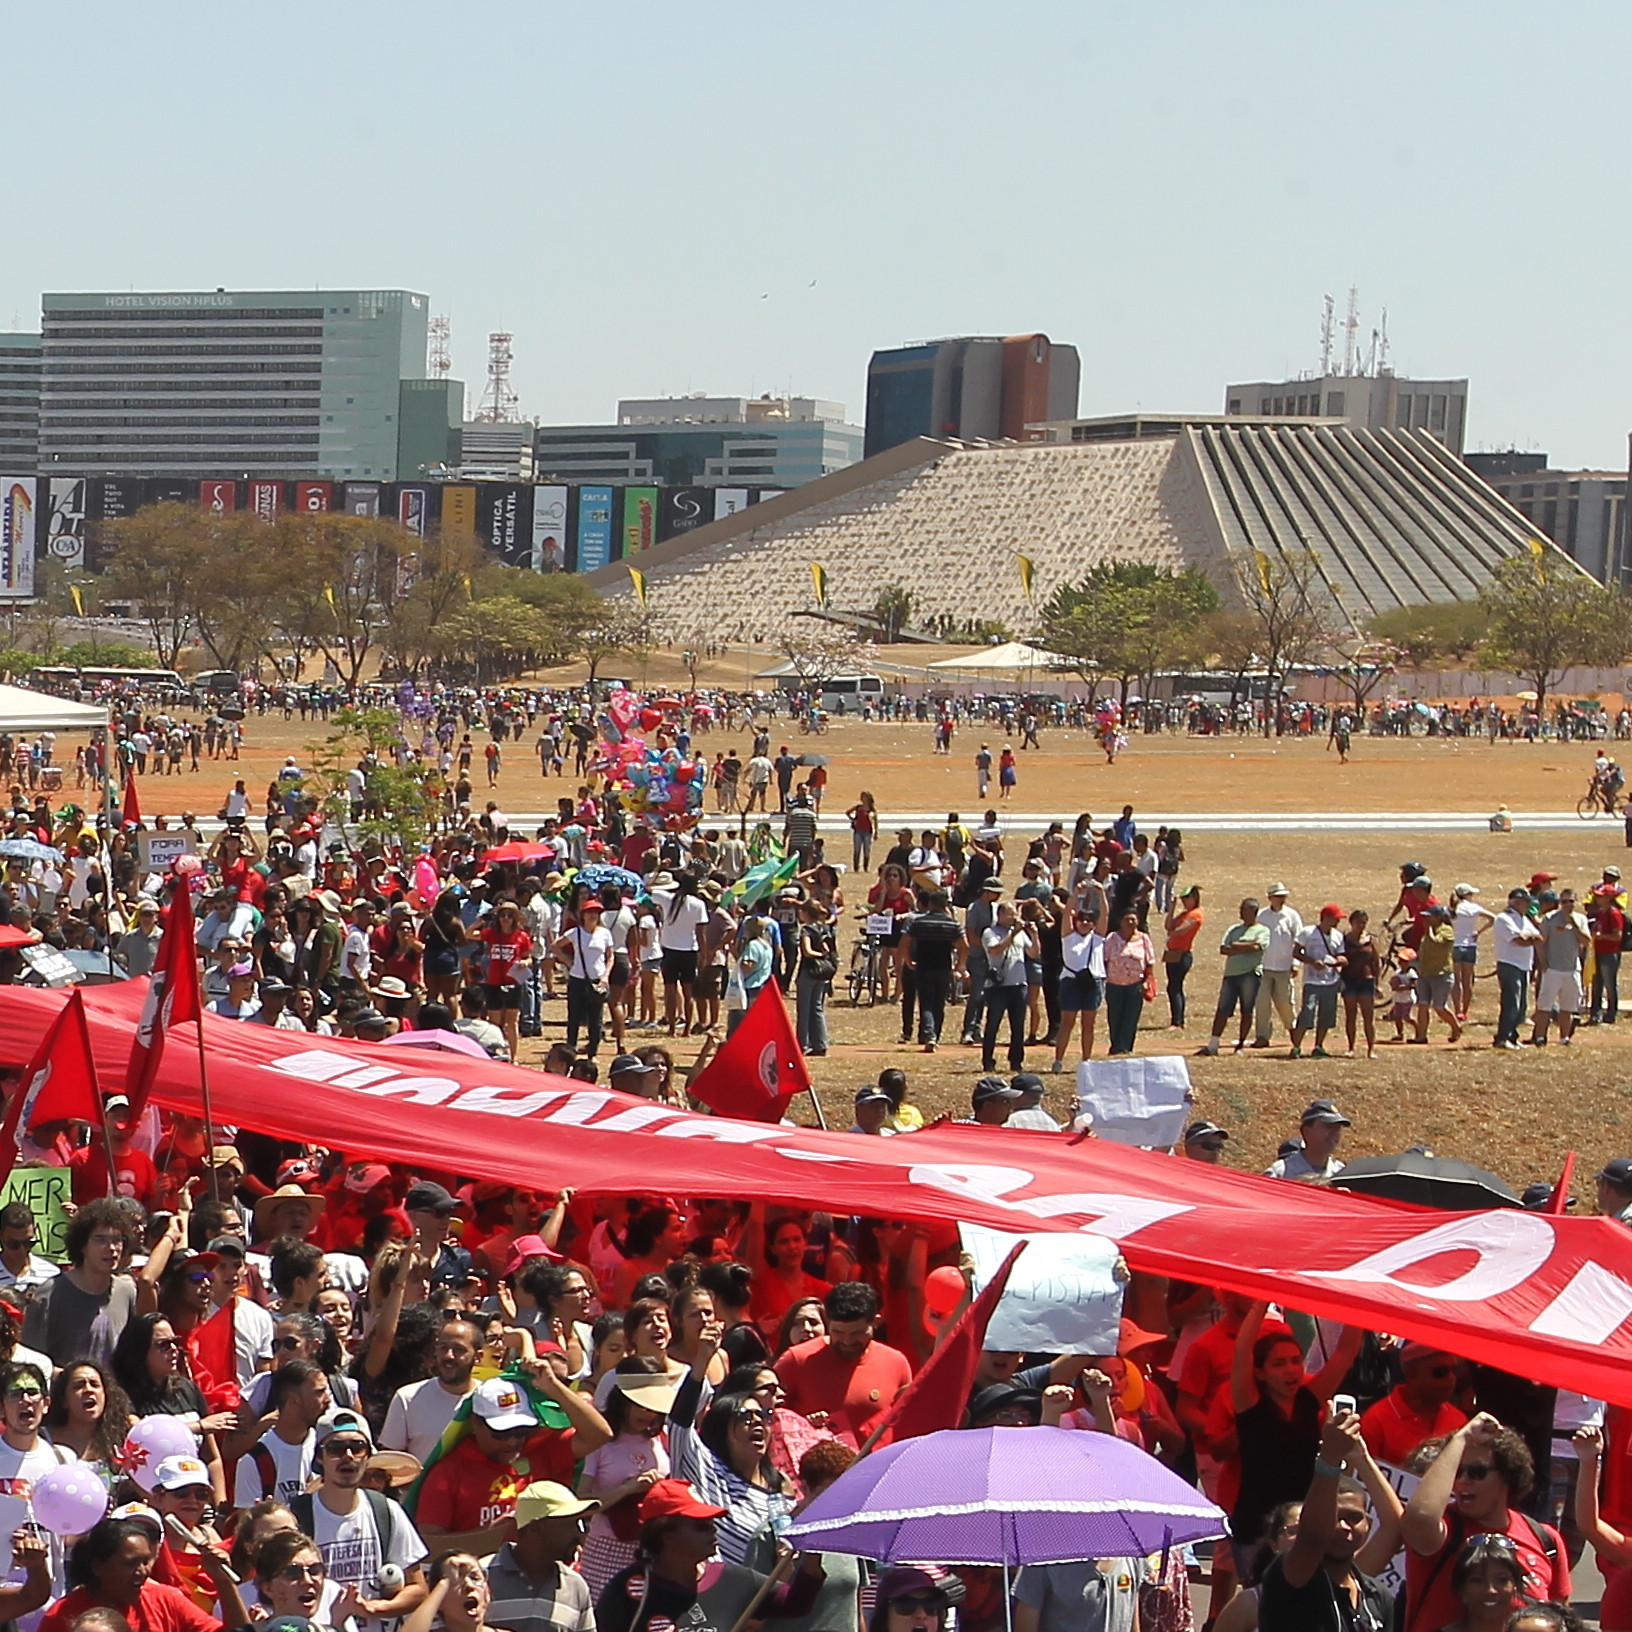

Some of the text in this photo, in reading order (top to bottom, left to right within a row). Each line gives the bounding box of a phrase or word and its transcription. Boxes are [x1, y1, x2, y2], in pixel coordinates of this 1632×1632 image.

[491, 498, 504, 545] ÓPTICA
[504, 489, 518, 553] VERSÁTIL
[150, 837, 185, 850] FORA
